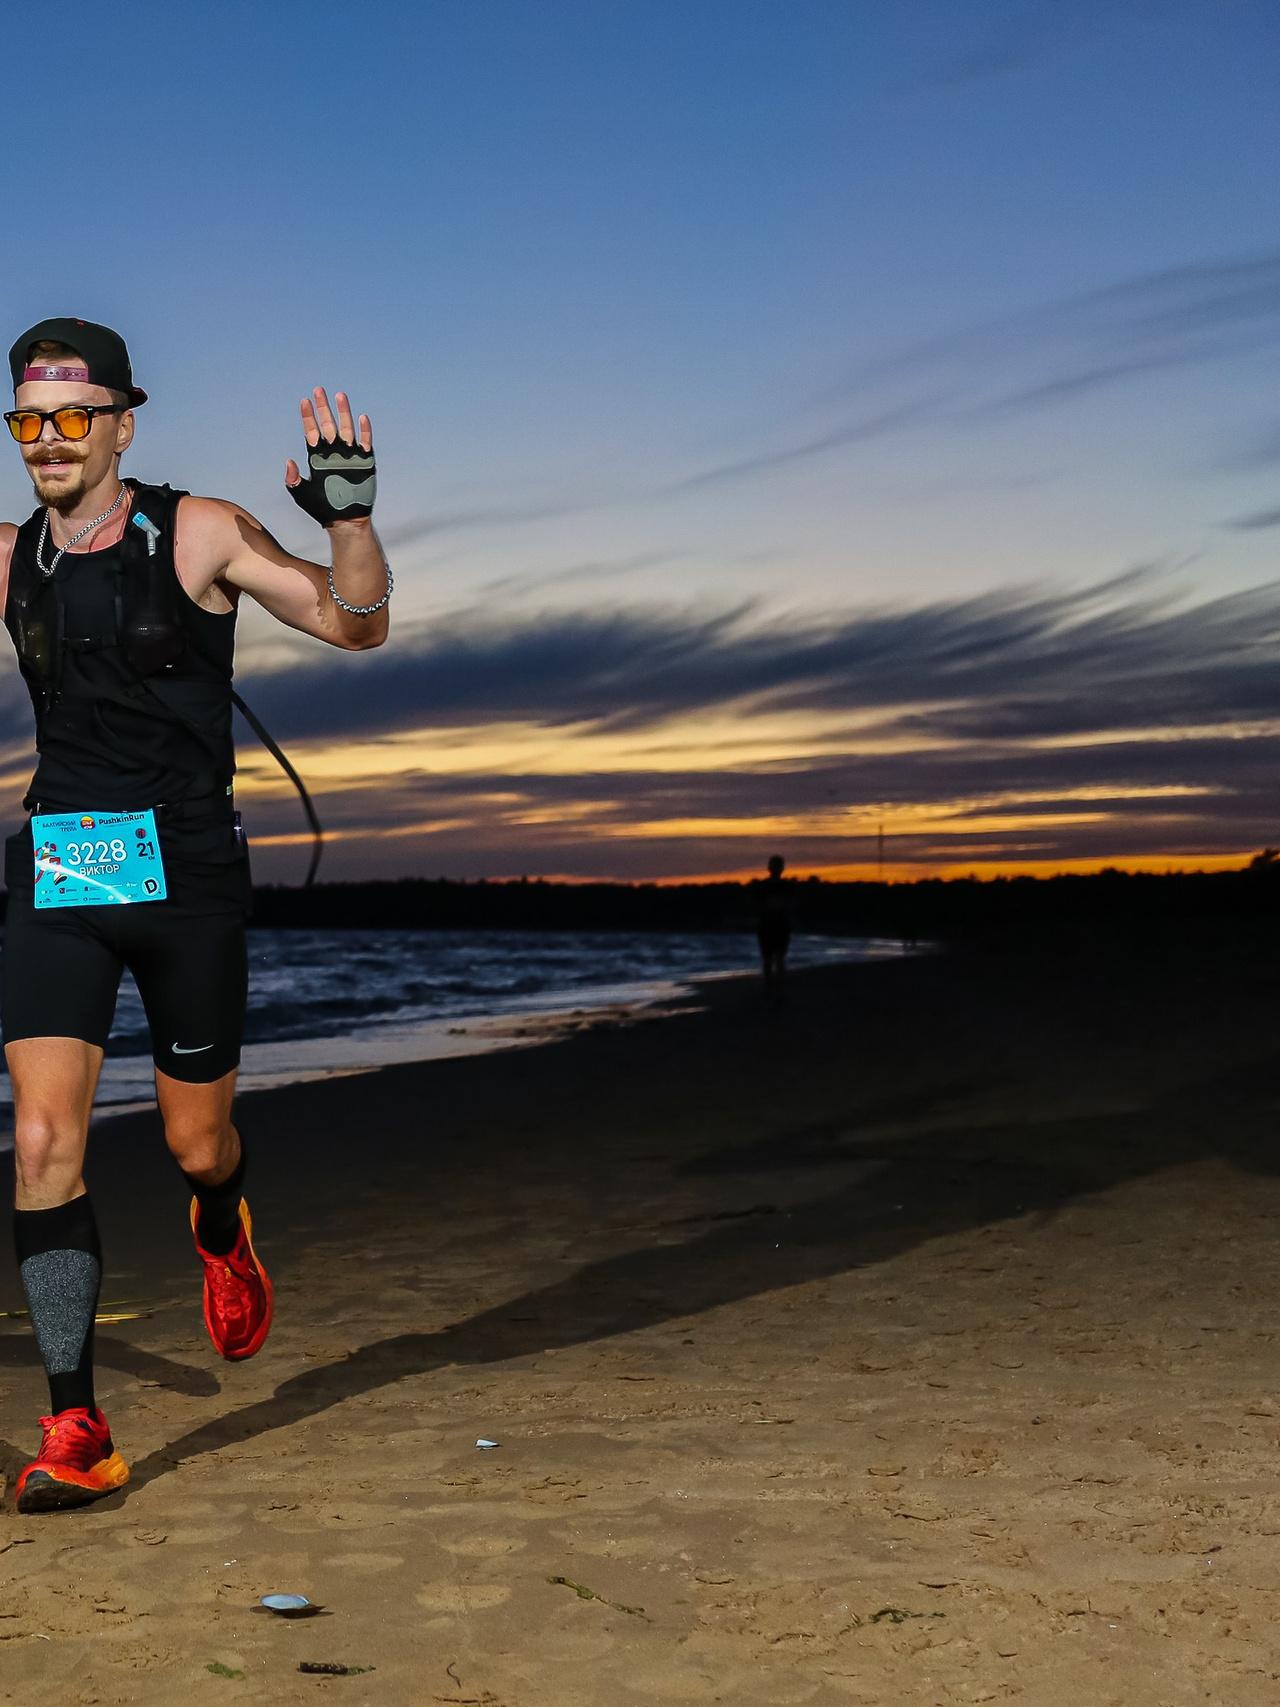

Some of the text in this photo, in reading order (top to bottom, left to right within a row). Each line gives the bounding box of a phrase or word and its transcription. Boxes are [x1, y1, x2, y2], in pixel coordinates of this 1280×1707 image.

[42, 820, 76, 828] БАЛТИЙСКИЙ
[98, 814, 145, 825] PushkinRun
[66, 839, 127, 866] 3228
[136, 841, 155, 857] 21
[80, 864, 120, 876] ВИКТОР
[144, 878, 158, 894] D
